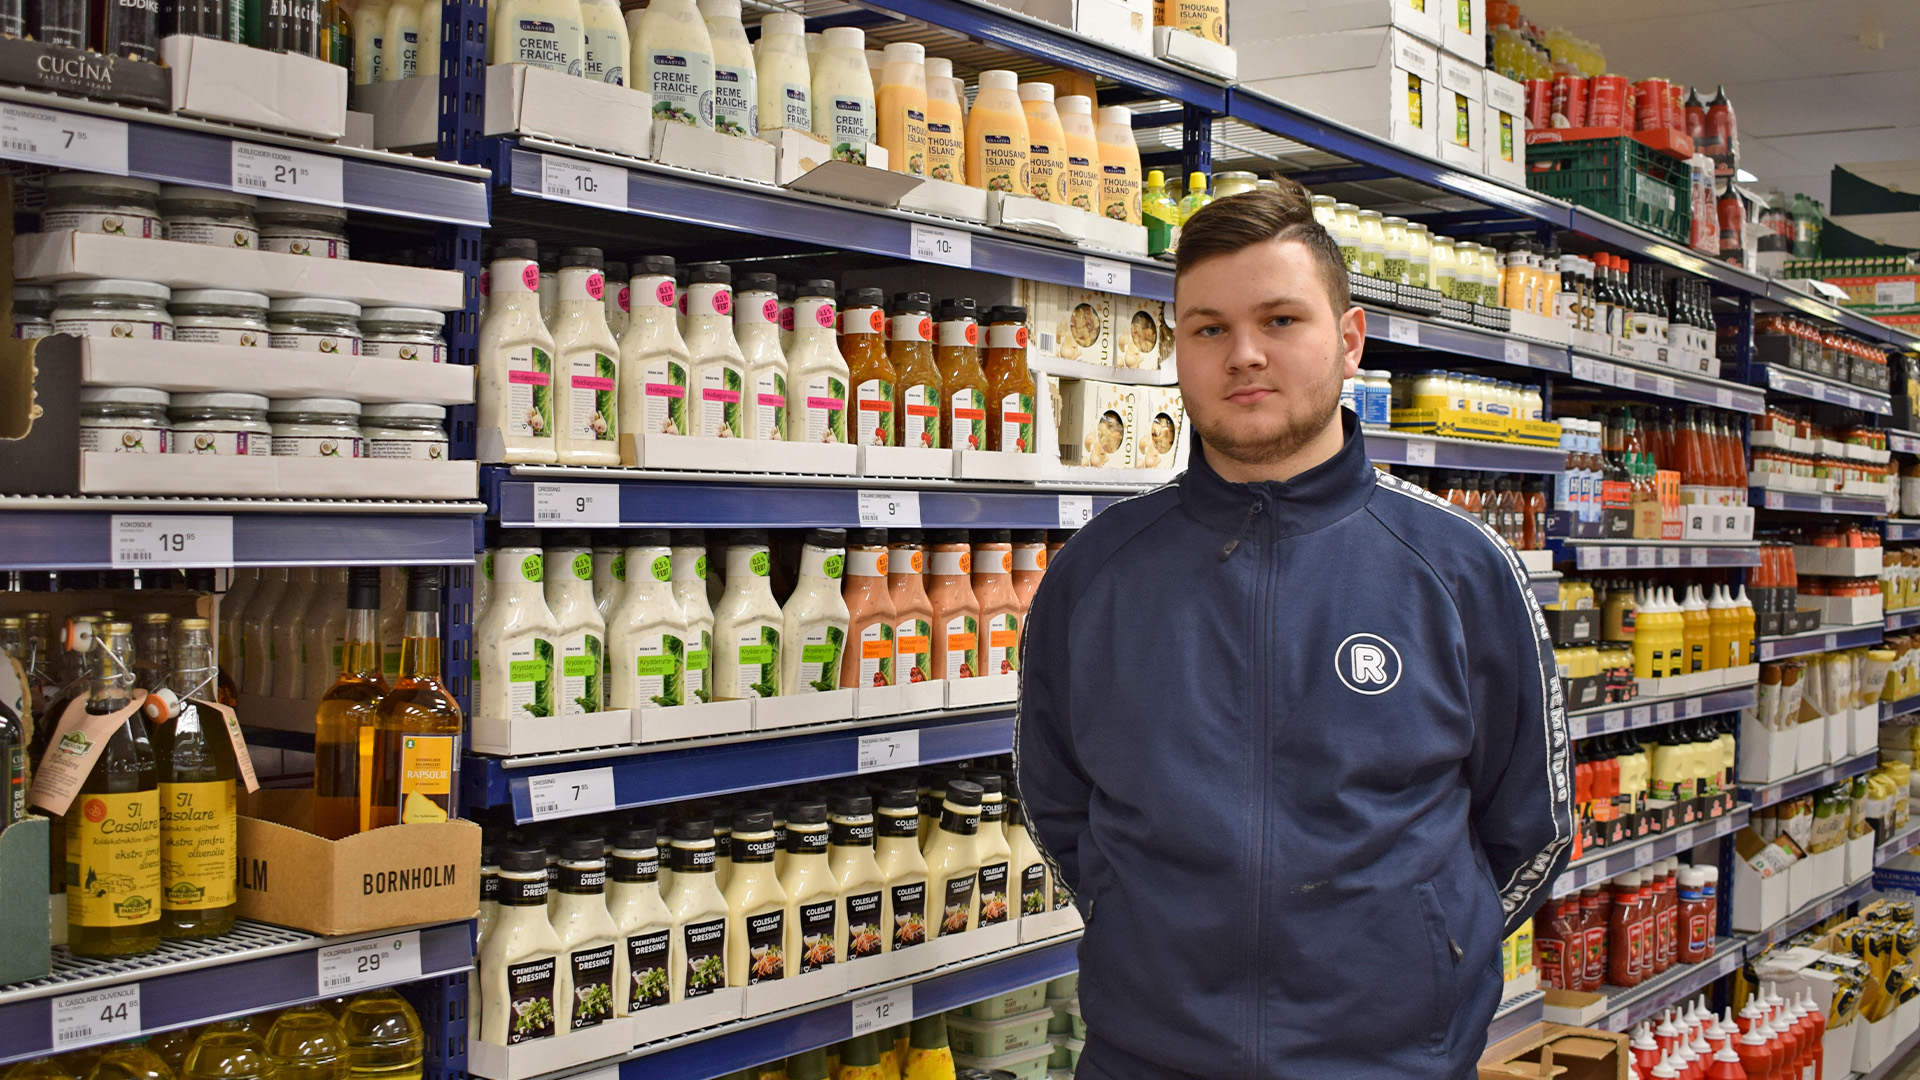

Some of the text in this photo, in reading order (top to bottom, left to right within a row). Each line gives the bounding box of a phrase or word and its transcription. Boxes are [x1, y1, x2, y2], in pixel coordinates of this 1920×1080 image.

[1180, 4, 1220, 14] THOUSAND
[1180, 11, 1208, 20] ISLAND
[520, 38, 558, 51] CREME
[520, 49, 566, 63] FRAICHE
[37, 55, 112, 84] CUCINA
[654, 71, 690, 84] CREME
[654, 82, 698, 94] FRAICHE
[787, 104, 807, 116] CREME
[836, 116, 864, 126] CREME
[77, 132, 88, 140] 95
[836, 125, 868, 137] FRAICHE
[62, 130, 75, 149] 7
[928, 137, 963, 150] THOUSAND
[928, 146, 955, 156] ISLAND
[985, 149, 1026, 160] THOUSAND
[986, 158, 1016, 166] ISLAND
[275, 165, 297, 184] 21
[1070, 178, 1092, 188] ISLAND
[1104, 178, 1140, 188] THOUSAND
[1104, 187, 1130, 195] ISLAND
[1107, 273, 1113, 285] 3
[1125, 393, 1136, 474] Crouton
[576, 497, 586, 512] 9
[888, 502, 896, 516] 9
[1082, 509, 1088, 520] 9
[159, 534, 184, 552] 19
[1350, 643, 1387, 685] R
[1550, 675, 1568, 803] REMA 1000
[888, 744, 894, 758] 7
[407, 770, 448, 780] RAPSOLIE
[176, 792, 194, 808] Il
[572, 786, 580, 801] 7
[127, 802, 143, 818] Il
[101, 818, 158, 834] Casolare
[166, 838, 194, 847] ekstra
[188, 849, 225, 858] olivenolie
[983, 866, 1006, 876] COLESLAW
[986, 872, 1004, 882] DRESSING
[363, 864, 456, 896] BORNHOLM
[897, 886, 923, 897] COLESLAW
[900, 893, 920, 902] DRESSING
[852, 896, 879, 906] COLESLAW
[855, 903, 876, 912] DRESSING
[806, 904, 834, 916] COLESLAW
[752, 914, 781, 928] COLESLAW
[810, 913, 831, 922] DRESSING
[688, 923, 724, 936] CREMEFRAICHE
[756, 923, 778, 934] DRESSING
[631, 934, 668, 948] CREMEFRAICHE
[692, 930, 721, 944] DRESSING
[635, 942, 666, 955] DRESSING
[358, 954, 380, 973] 29
[574, 950, 613, 964] CREMEFRAICHE
[512, 962, 554, 977] CREMEFRAICHE
[578, 958, 610, 971] DRESSING
[516, 970, 550, 984] DRESSING
[66, 996, 98, 1008] CASOLARE
[100, 988, 135, 1001] OLIVENOLIE
[128, 1000, 138, 1008] 95
[100, 1002, 128, 1024] 44
[876, 1004, 890, 1019] 12
